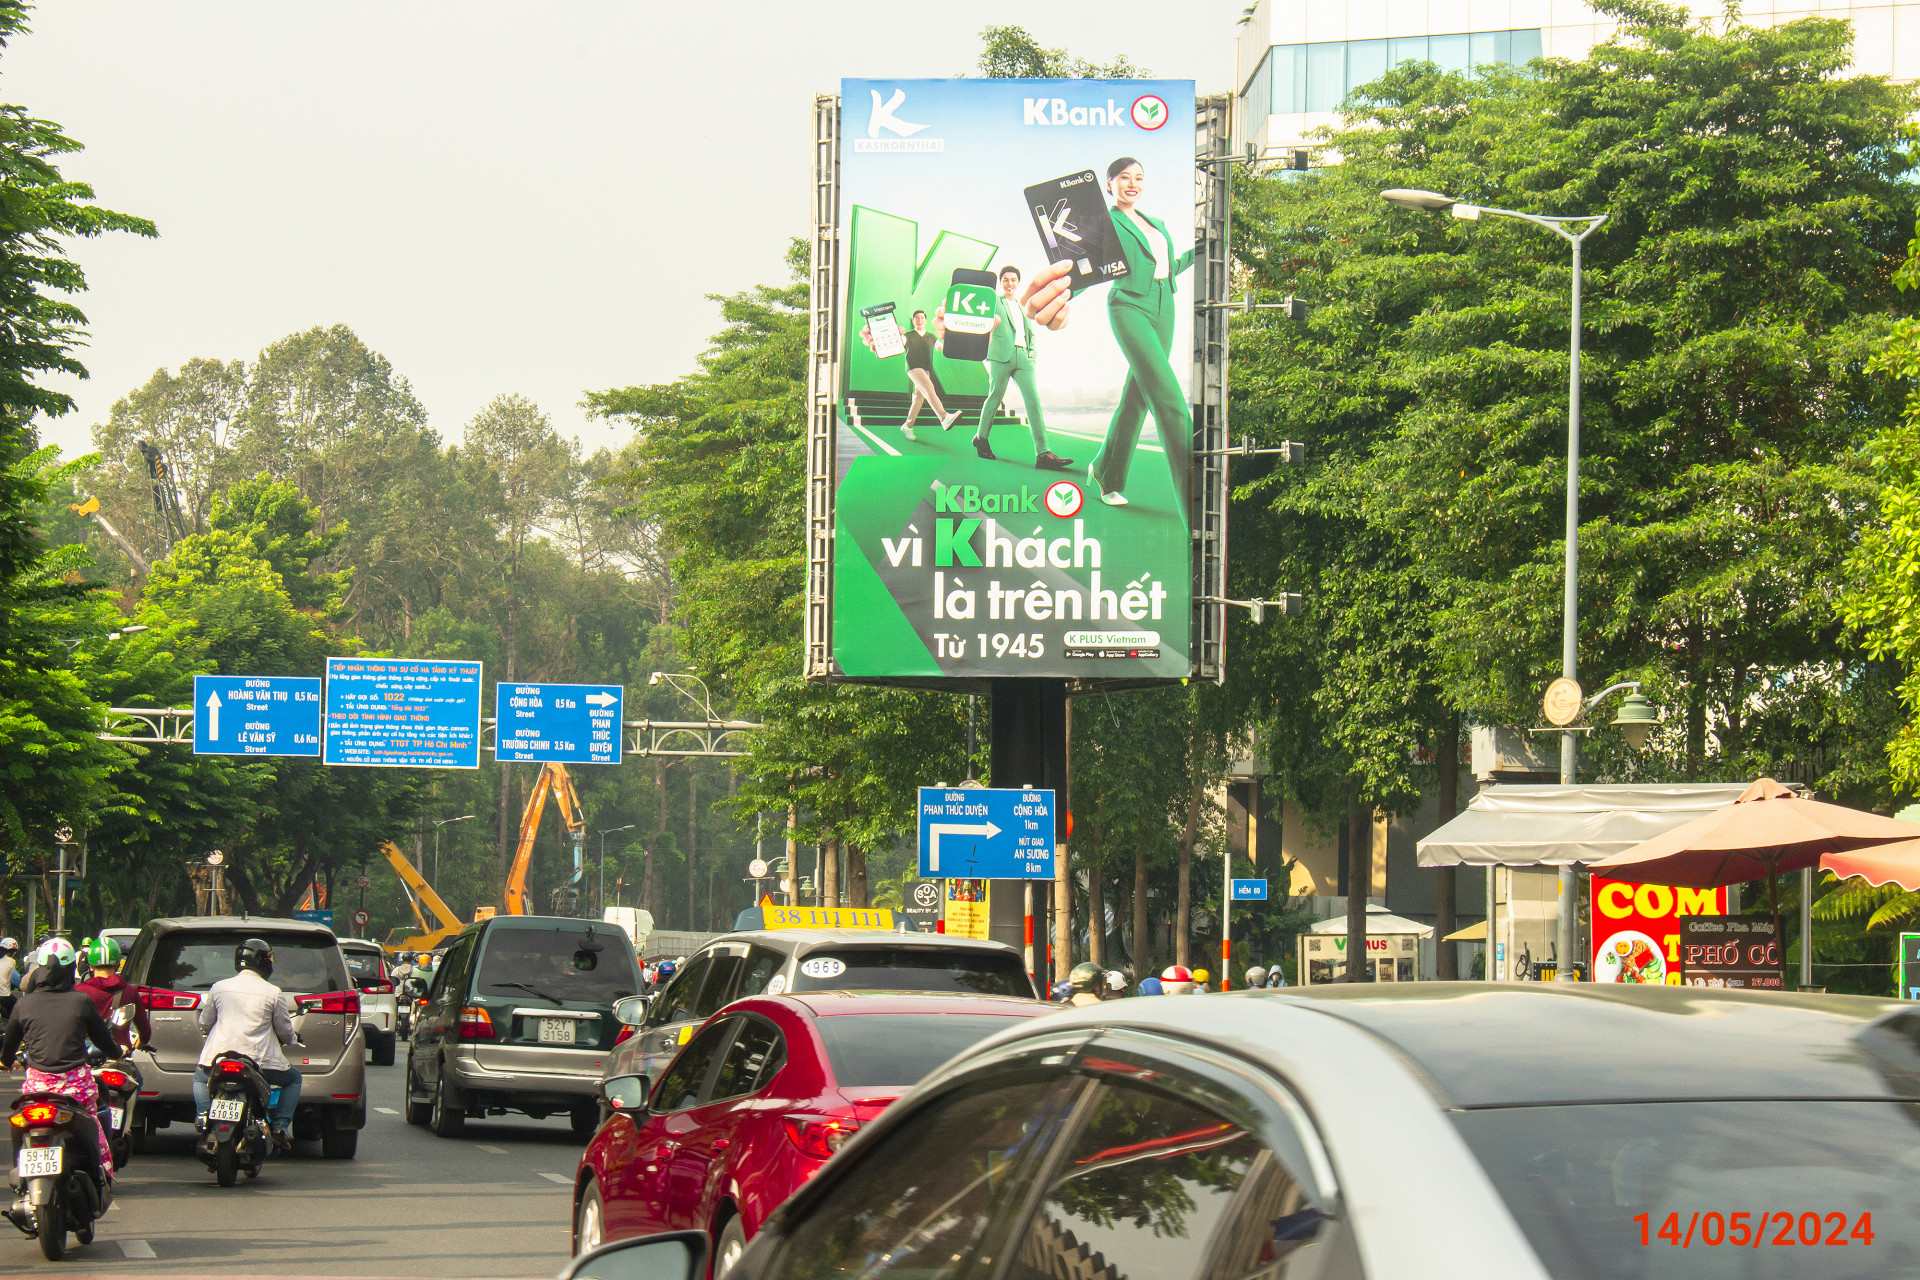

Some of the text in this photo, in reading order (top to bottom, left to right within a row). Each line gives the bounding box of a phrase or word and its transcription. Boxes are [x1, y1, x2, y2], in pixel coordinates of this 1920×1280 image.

[1024, 98, 1125, 126] KBank
[858, 142, 941, 150] KASIKORNTHAI
[1060, 176, 1084, 188] KBank
[1098, 260, 1126, 275] VISA
[952, 291, 990, 315] K+
[954, 320, 986, 328] Vietnam
[936, 485, 1038, 513] KBank
[882, 518, 1101, 568] vì Khách
[934, 571, 1166, 620] là trên hết
[1070, 634, 1146, 643] K PLUS Vietnam
[934, 633, 1044, 658] Từ 1945
[515, 685, 540, 694] ĐƯỜNG
[228, 689, 254, 700] HOÀNG
[256, 690, 270, 700] VĂN
[273, 692, 288, 702] THỤ
[307, 692, 318, 702] Km
[384, 693, 405, 701] 1022
[246, 703, 268, 711] Street
[510, 696, 528, 708] CỘNG
[529, 696, 543, 708] HÒA
[566, 699, 576, 708] Km
[516, 710, 535, 718] Street
[589, 708, 614, 718] ĐƯỜNG
[592, 719, 611, 728] PHAN
[238, 731, 247, 742] LÊ
[250, 733, 264, 742] VĂN
[266, 732, 276, 742] SỸ
[306, 734, 318, 744] Km
[515, 728, 540, 737] ĐƯỜNG
[592, 729, 610, 740] THÚC
[502, 738, 528, 750] TRƯỜNG
[530, 740, 550, 750] CHINH
[565, 741, 575, 751] Km
[590, 742, 612, 753] DUYỆN
[945, 792, 964, 802] ĐƯỜNG
[1023, 792, 1041, 802] ĐƯỜNG
[924, 802, 988, 818] PHAN THÚC DUYỆN
[1014, 804, 1048, 818] CỘNG HÒA
[1019, 835, 1044, 846] NÚT GIAO
[1014, 849, 1049, 860] AN SƯƠNG
[774, 909, 883, 926] 38 111 111
[1689, 922, 1724, 932] Coffee
[1727, 922, 1749, 932] Pha
[1685, 938, 1739, 964] PHỐ
[806, 962, 840, 974] 1969
[547, 1020, 567, 1030] 52Y
[544, 1031, 570, 1041] 3158
[216, 1101, 240, 1111] 78-G1
[26, 1150, 55, 1161] 59-H2
